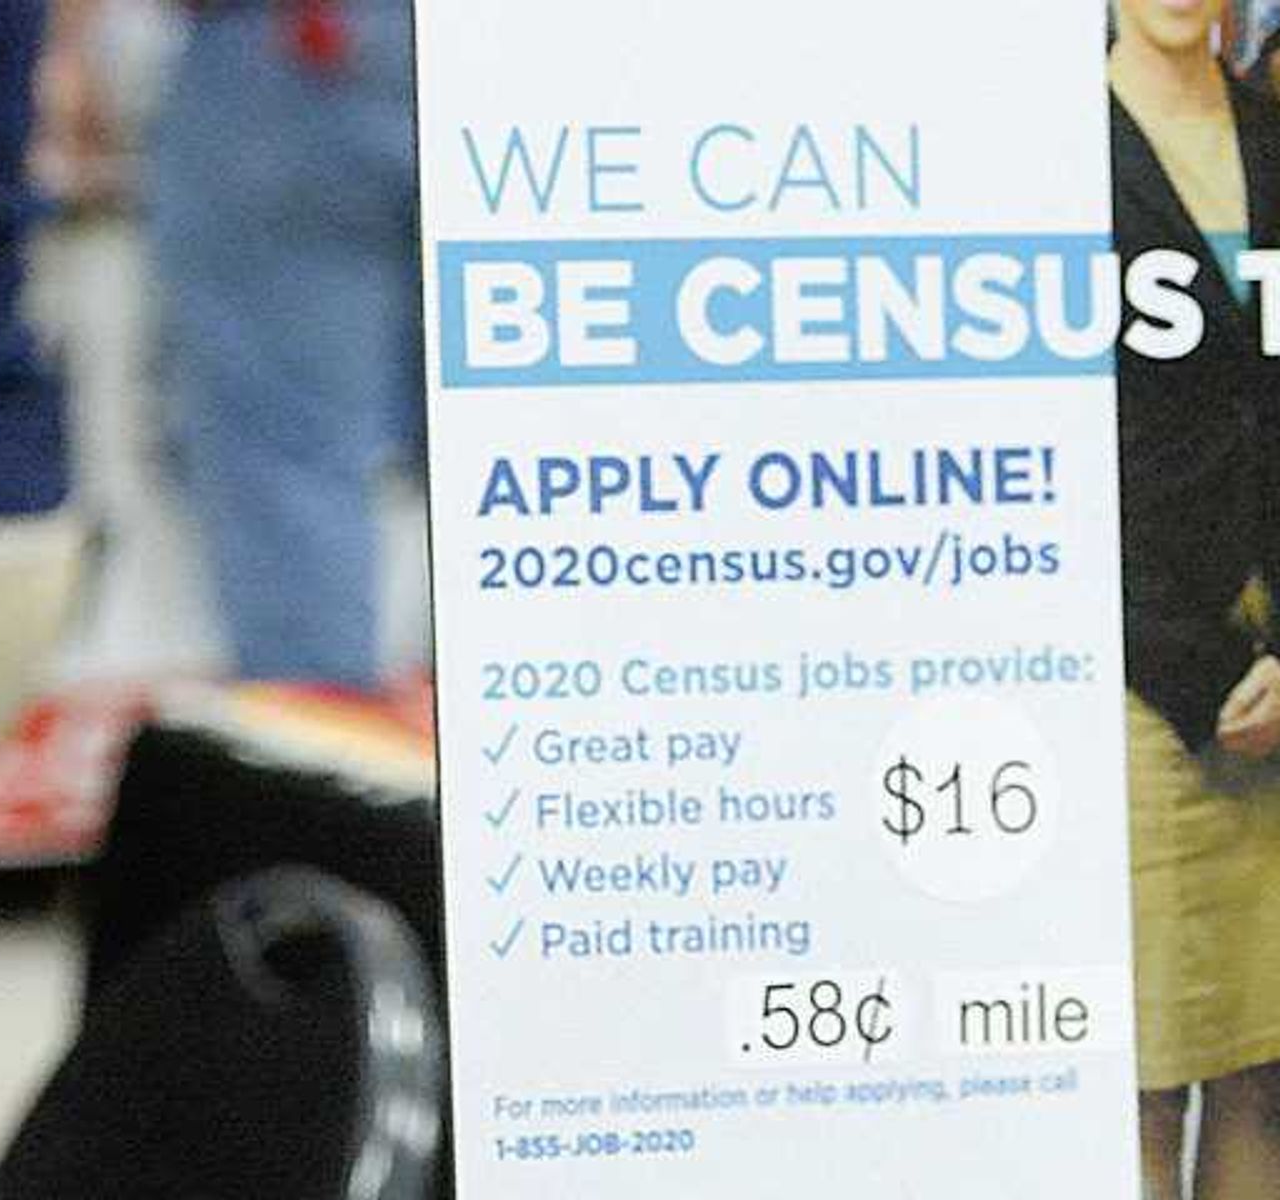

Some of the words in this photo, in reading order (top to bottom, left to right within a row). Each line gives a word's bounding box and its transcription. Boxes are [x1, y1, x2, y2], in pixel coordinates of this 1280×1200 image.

[461, 125, 645, 214] WE
[689, 123, 921, 212] CAN
[463, 258, 638, 369] BE
[675, 247, 1205, 366] CENSUS
[476, 453, 722, 516] APPLY
[747, 445, 1056, 511] ONLINE!
[479, 529, 1061, 590] 2020census.gov/jobs
[482, 660, 603, 700] 2020
[620, 655, 783, 696] Census
[797, 651, 894, 698] jobs
[910, 645, 1098, 694] provide:
[532, 728, 651, 766] Great
[666, 727, 743, 764] pay
[535, 789, 704, 828] Flexible
[718, 786, 837, 822] hours
[881, 755, 1038, 844] $16
[538, 853, 696, 897] Weekly
[711, 853, 788, 893] pay
[540, 917, 634, 960] Paid
[648, 913, 813, 957] training
[741, 976, 894, 1062] .58¢
[959, 982, 1090, 1045] mile
[493, 1096, 534, 1118] For
[540, 1097, 602, 1116] more
[611, 1089, 748, 1114] information
[757, 1089, 780, 1105] or
[495, 1129, 696, 1161] 1-855-JOB-2020
